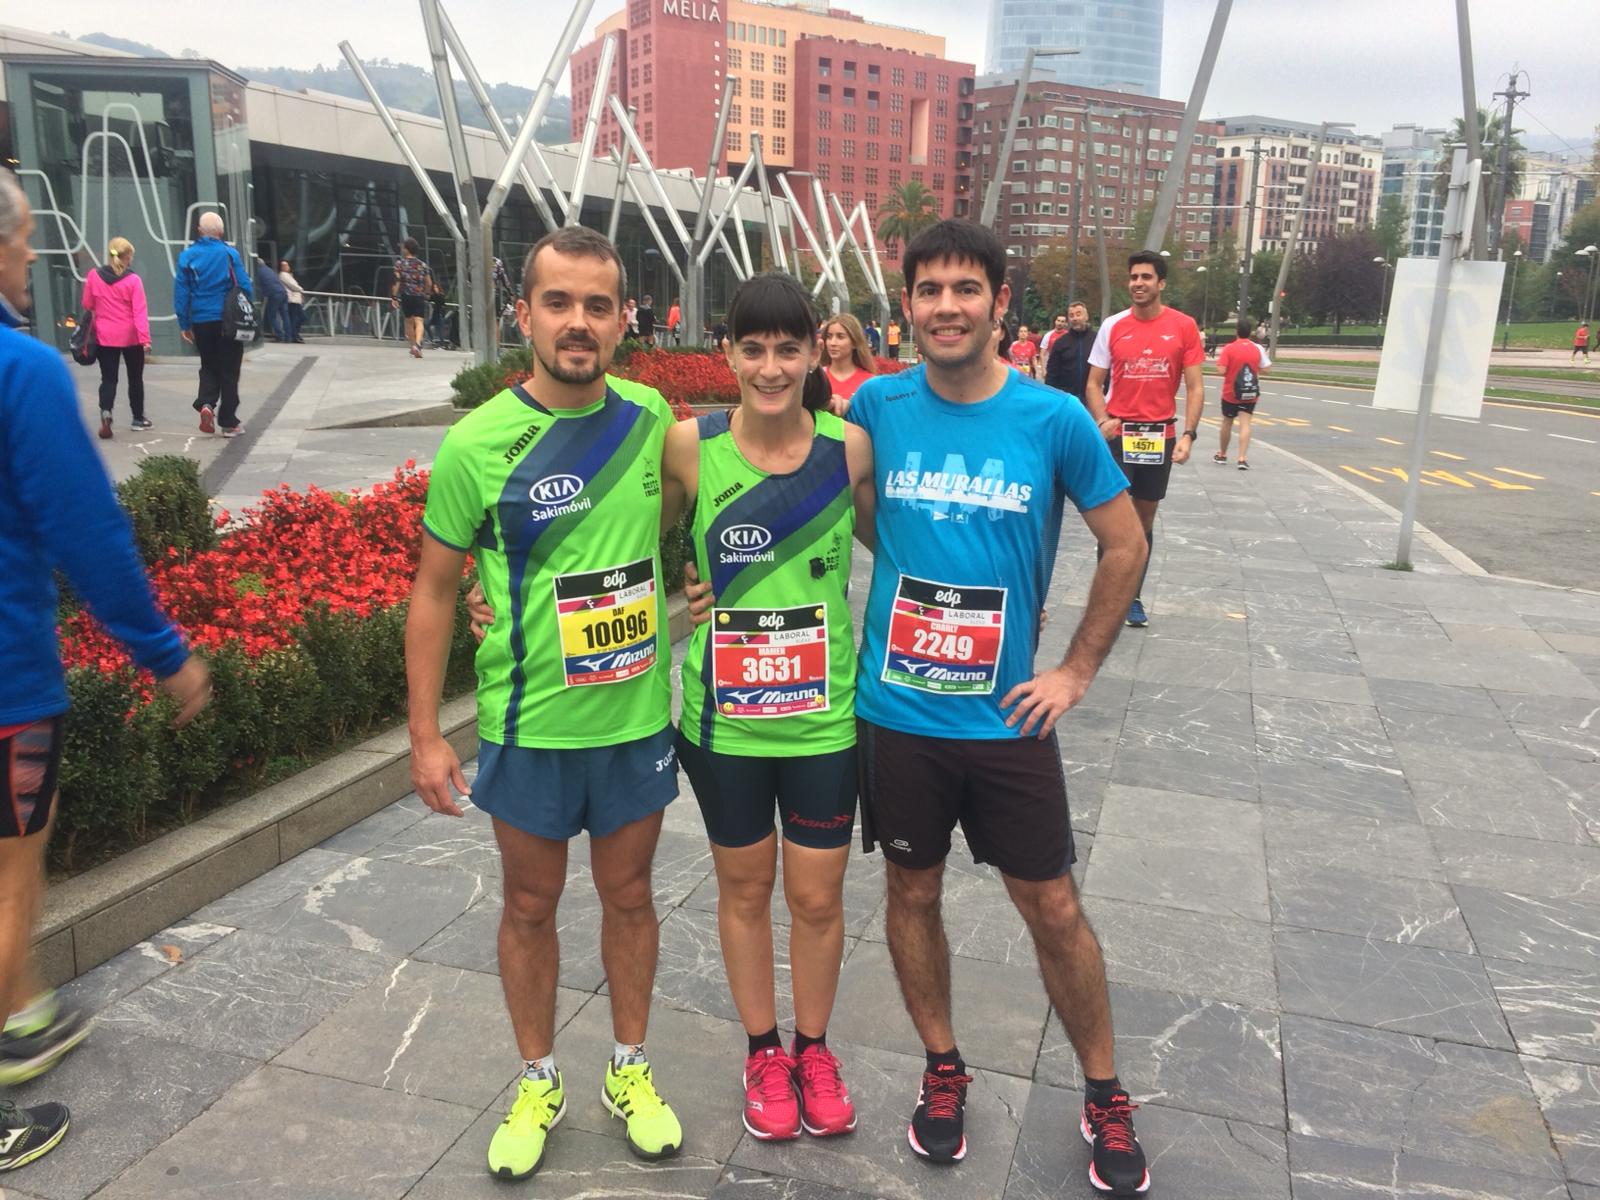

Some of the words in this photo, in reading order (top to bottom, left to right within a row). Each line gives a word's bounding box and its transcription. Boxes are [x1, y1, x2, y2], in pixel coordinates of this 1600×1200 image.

[538, 478, 577, 501] KIA
[886, 470, 919, 487] LAS
[920, 471, 1033, 502] MURALLAS
[532, 497, 592, 522] Sakimóvil
[729, 530, 763, 545] KIA
[719, 551, 775, 564] Sakimóvil
[602, 570, 627, 589] edp
[619, 585, 647, 599] LABORAL
[934, 589, 961, 608] edp
[758, 612, 785, 630] edp
[948, 610, 985, 620] LABORAL
[582, 610, 648, 649] 10096
[774, 630, 811, 641] LABORAL
[912, 629, 974, 661] 2249
[742, 655, 801, 683] 3631
